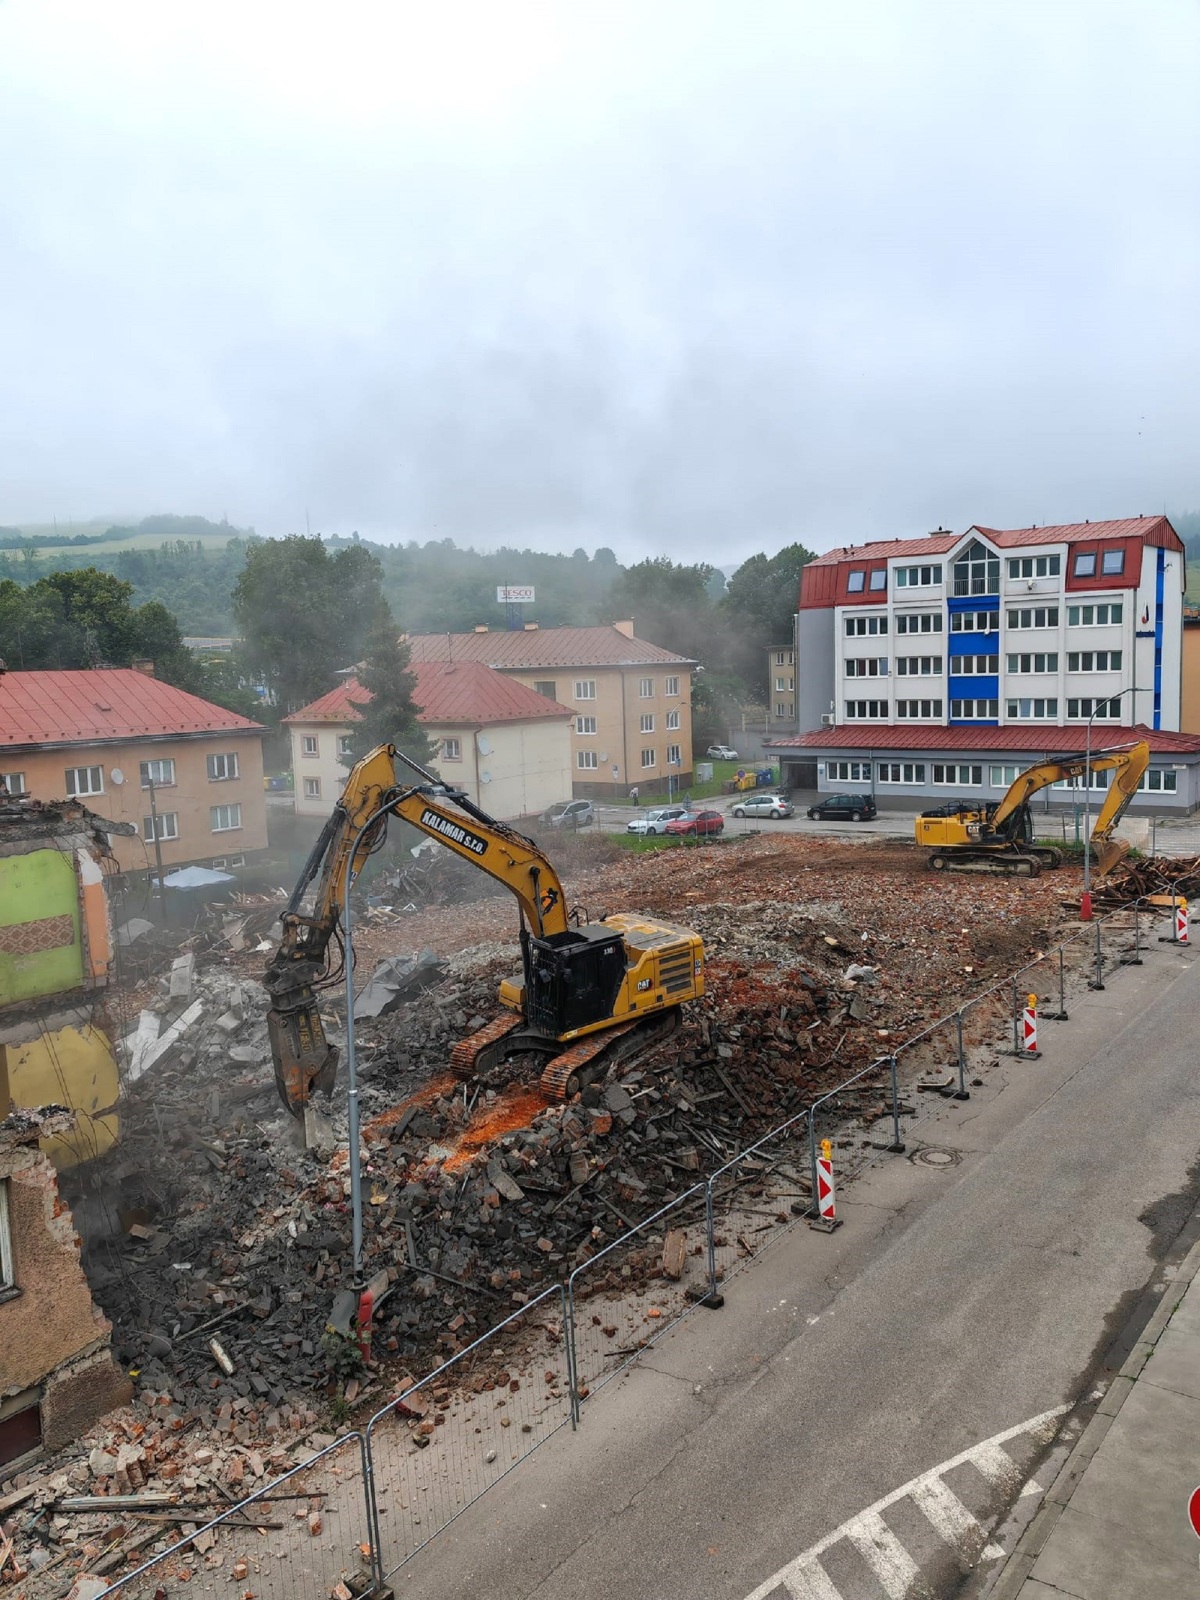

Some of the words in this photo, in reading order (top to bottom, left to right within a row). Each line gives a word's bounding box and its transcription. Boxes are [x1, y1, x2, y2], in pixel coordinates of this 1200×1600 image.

[421, 811, 466, 843] KALAMAR
[967, 826, 980, 834] CAT
[637, 979, 650, 991] CAT
